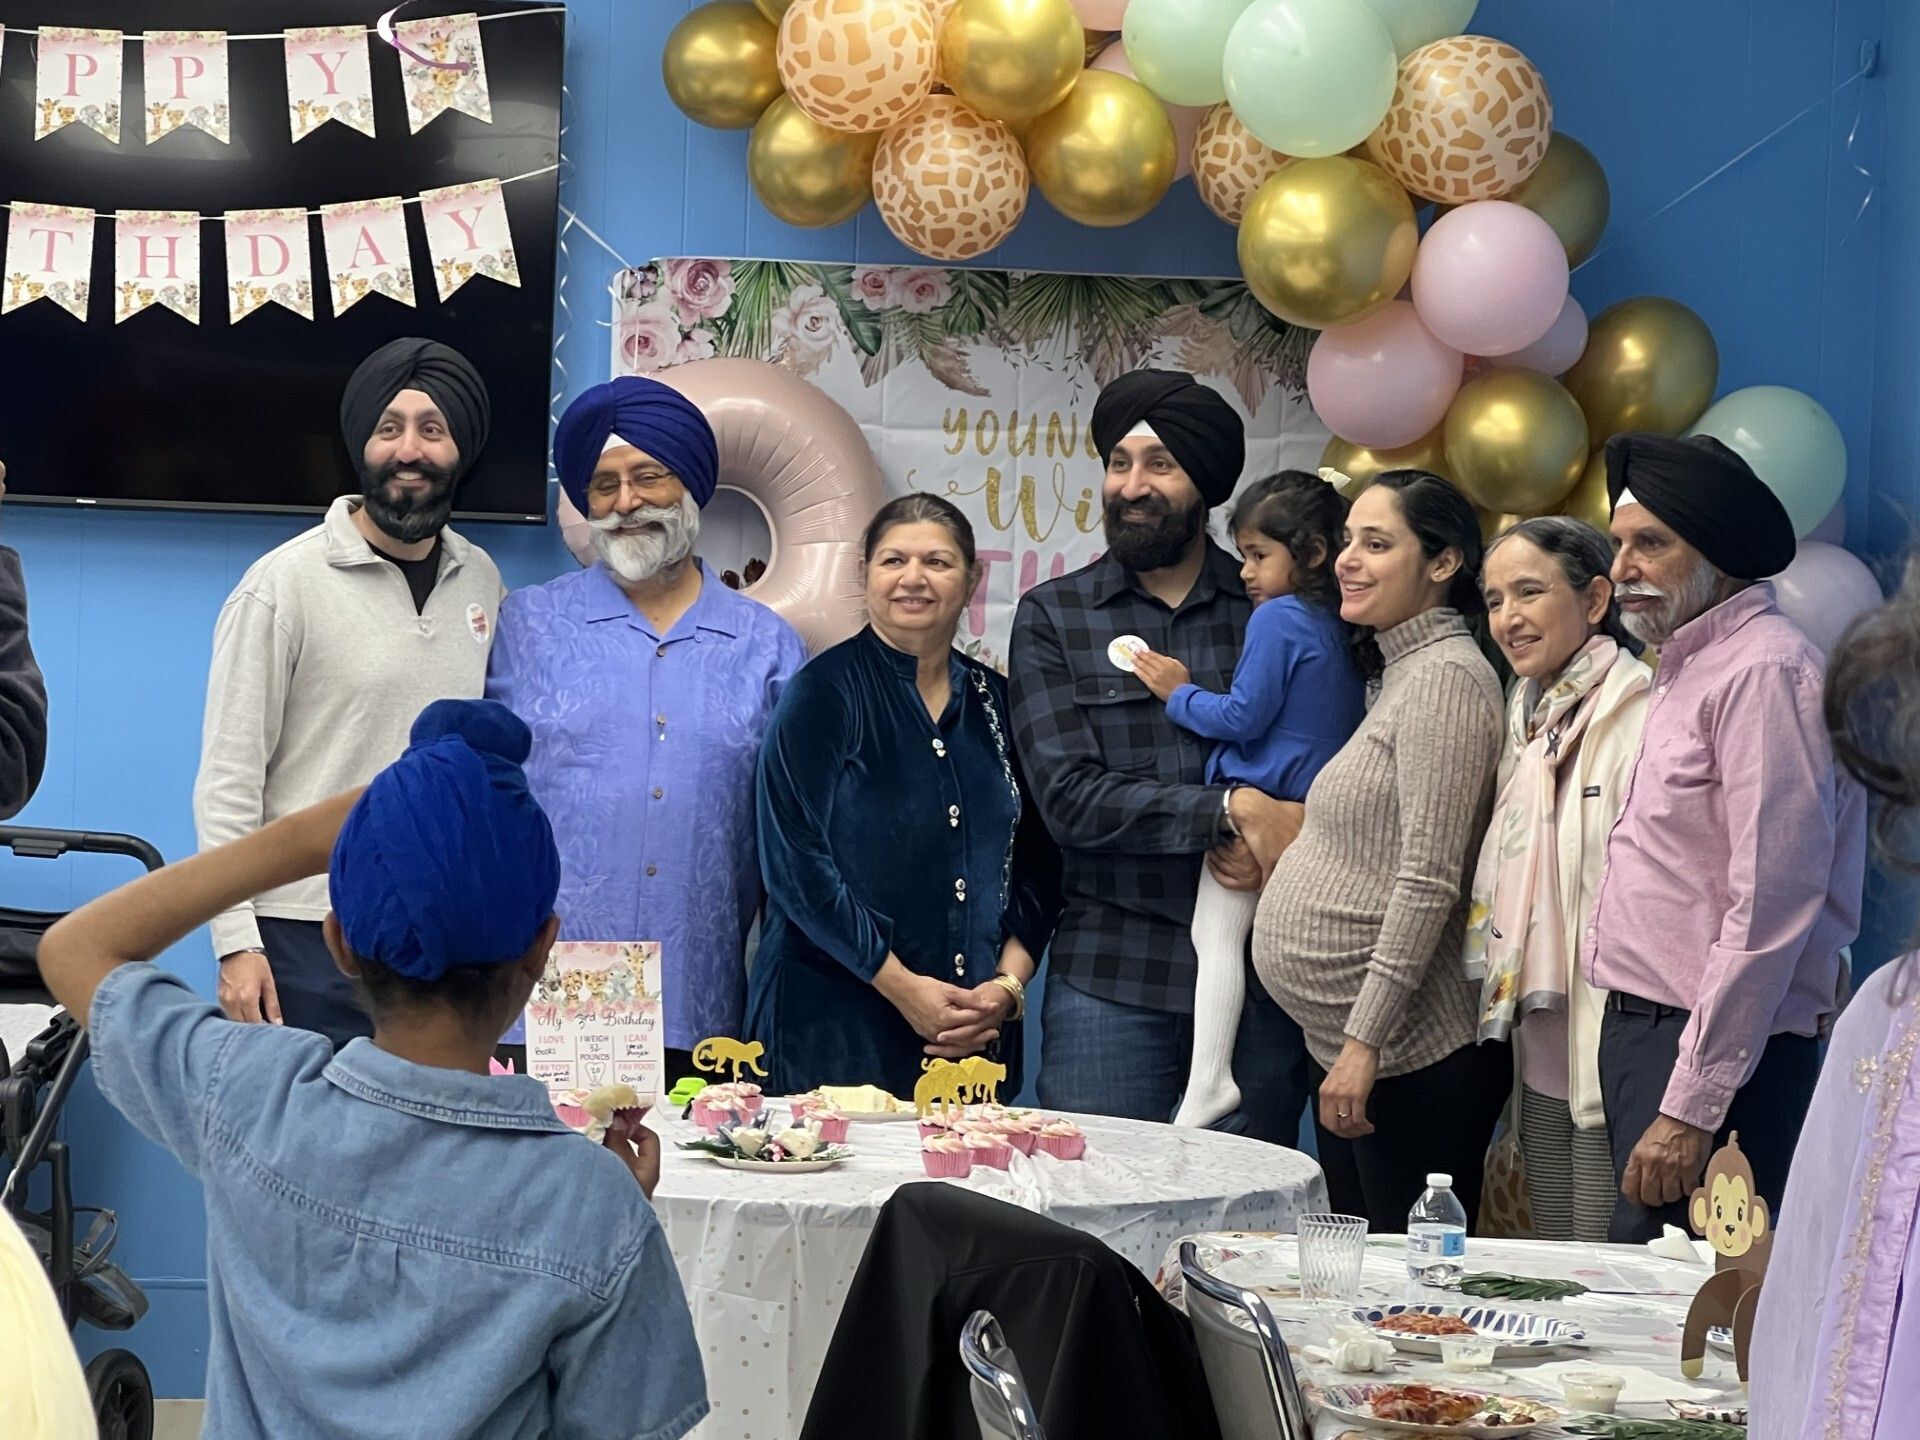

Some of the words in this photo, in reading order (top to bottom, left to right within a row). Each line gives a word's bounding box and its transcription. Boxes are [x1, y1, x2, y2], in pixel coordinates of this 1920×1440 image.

[946, 462, 1105, 543] Wi
[538, 1008, 562, 1031] My
[574, 1012, 597, 1030] 3rd
[602, 1008, 655, 1031] Birthday
[543, 1035, 565, 1044] LOVE
[628, 1034, 648, 1043] CAN
[580, 1053, 610, 1061] POUNDS
[535, 1063, 550, 1071] FAV
[551, 1063, 570, 1071] TOYS
[618, 1063, 633, 1071] FAV
[634, 1063, 655, 1071] FOOD
